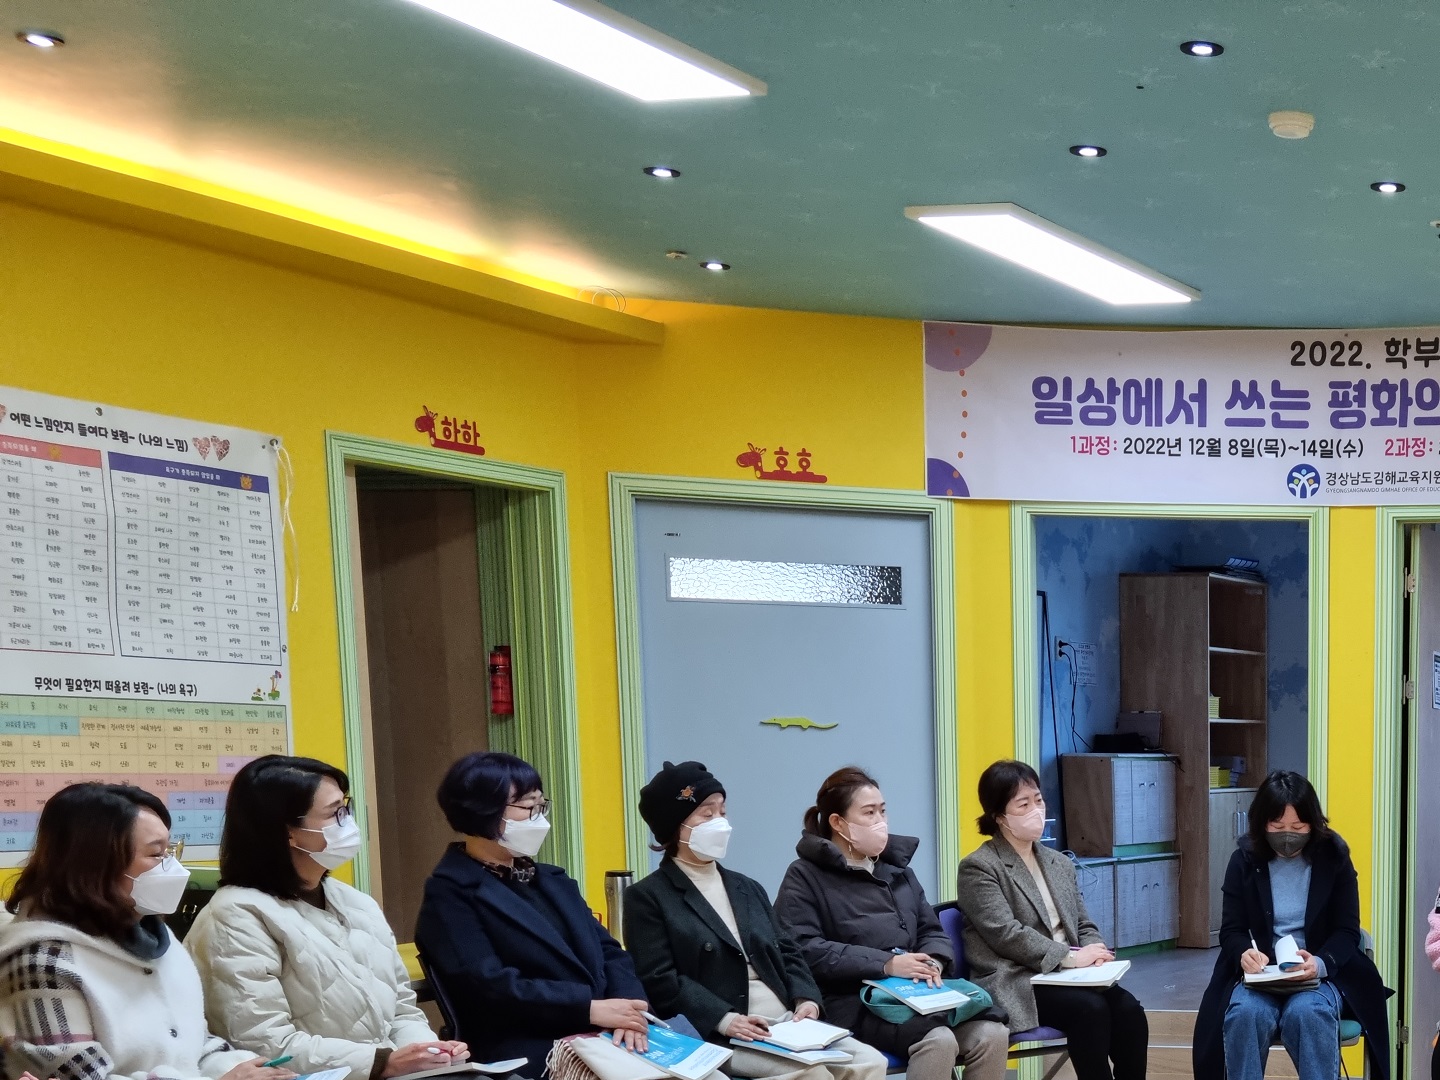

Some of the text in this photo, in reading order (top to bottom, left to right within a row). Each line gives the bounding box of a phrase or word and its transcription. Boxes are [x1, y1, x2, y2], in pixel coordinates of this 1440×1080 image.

[1290, 340, 1371, 369] 2022.
[1031, 375, 1209, 427] 일상에서
[1224, 378, 1311, 428] 쓰는
[9, 412, 31, 428] 어떤
[34, 416, 74, 434] 느낌인지
[77, 422, 108, 439] 들여다
[138, 432, 163, 448] (나의
[165, 437, 189, 453] 느낌)
[441, 415, 480, 445] 하하
[773, 446, 812, 473] 호호
[1069, 435, 1118, 456] 1과정:
[1123, 437, 1182, 457] 2022년
[1188, 438, 1222, 457] 12월
[1228, 438, 1364, 459] 8일(목)~14일(수)
[1384, 438, 1433, 458] 2과정:
[34, 676, 198, 698] 무엇이 필요한지 떠올려 보렴~ (나의 욕구)
